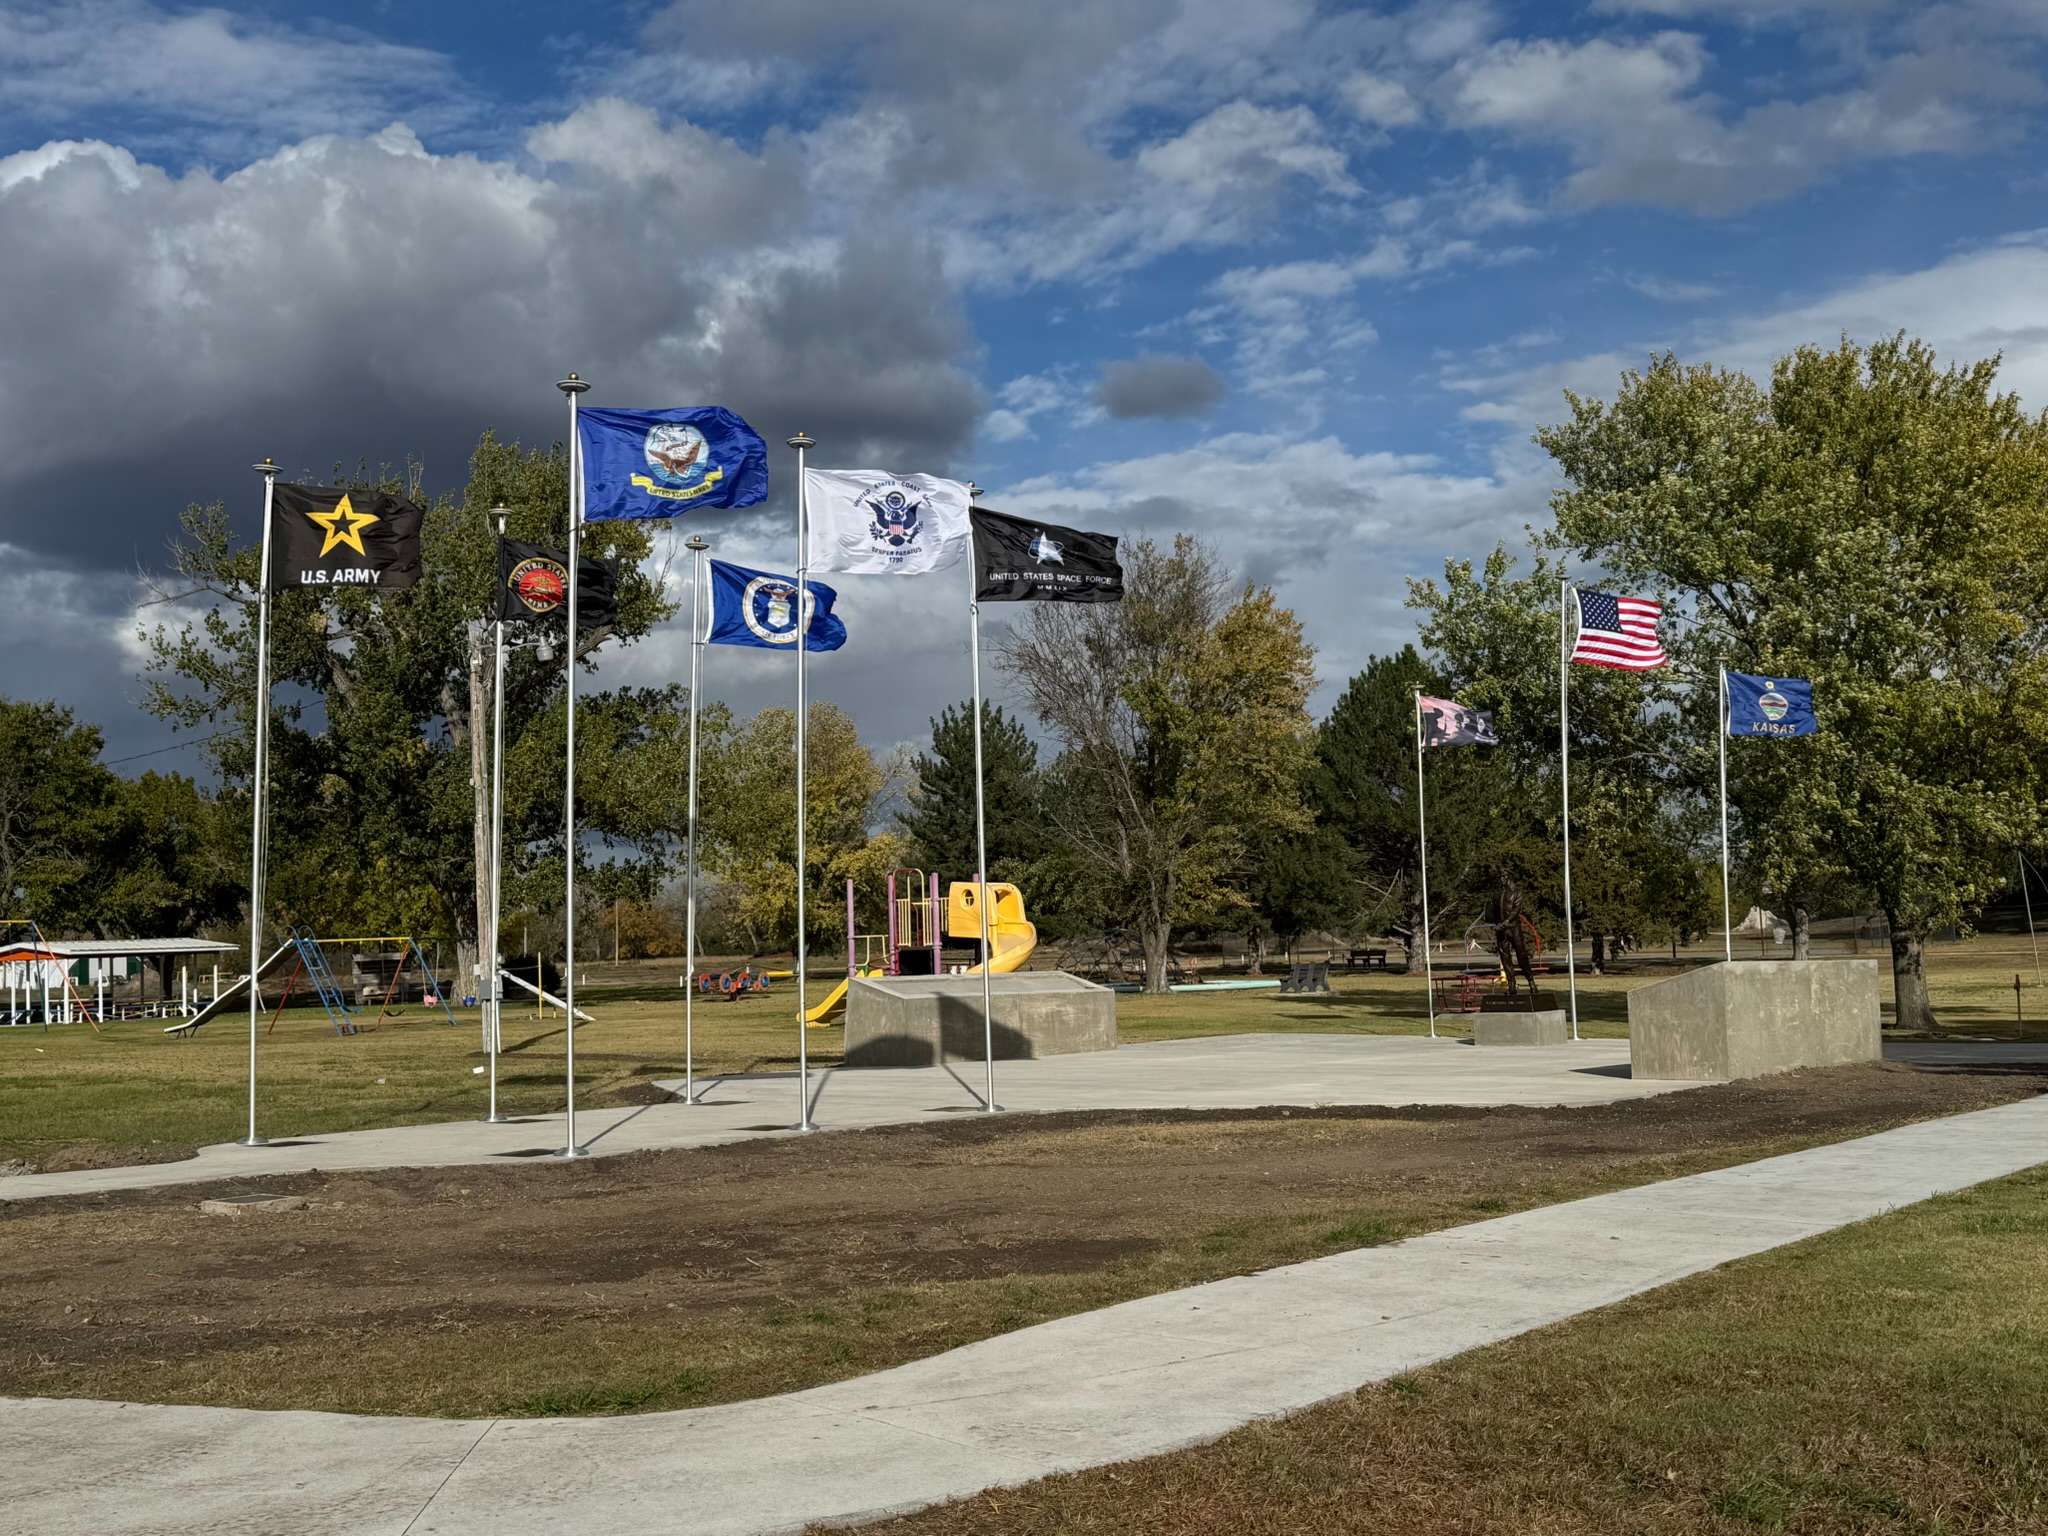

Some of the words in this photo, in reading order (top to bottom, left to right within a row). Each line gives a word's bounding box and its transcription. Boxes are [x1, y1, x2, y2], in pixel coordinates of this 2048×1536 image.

[853, 488, 871, 507] UNITED
[901, 481, 921, 493] COAST
[889, 556, 904, 564] 1790
[300, 569, 330, 584] U.S.
[332, 568, 381, 584] ARMY
[514, 562, 544, 582] UNITED
[546, 563, 568, 589] STATES
[989, 572, 1020, 581] UNITED
[1023, 572, 1054, 581] STATES
[1056, 574, 1082, 583] SPACE
[1085, 575, 1112, 585] FORCE
